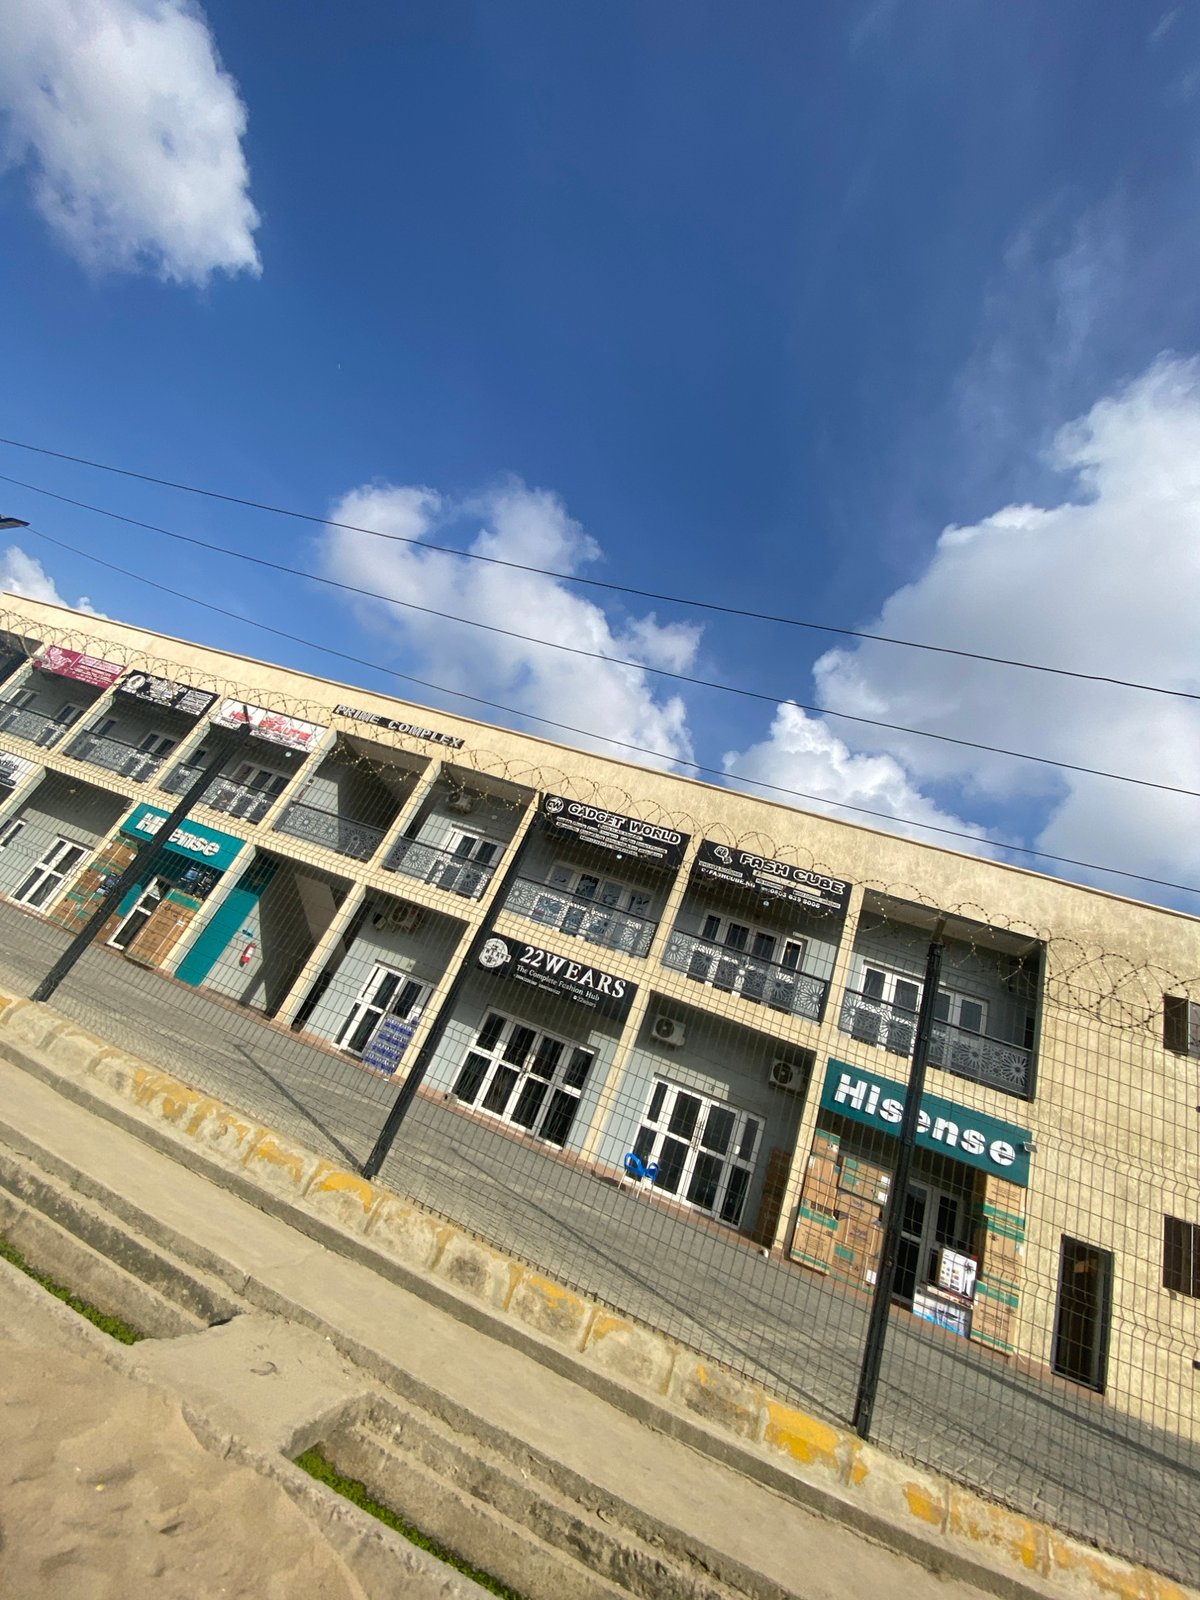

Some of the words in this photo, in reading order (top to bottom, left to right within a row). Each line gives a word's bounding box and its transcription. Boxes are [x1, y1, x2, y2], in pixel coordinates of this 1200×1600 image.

[335, 704, 381, 724] PRIME
[387, 720, 461, 748] COMPLEX
[568, 803, 625, 829] GADGET
[629, 821, 681, 845] WORLD
[740, 852, 790, 877] FASH
[793, 869, 846, 895] CUBE
[516, 964, 528, 975] The
[528, 968, 558, 986] Complete
[558, 980, 584, 996] Fashion
[585, 990, 600, 1002] Hub
[519, 945, 627, 999] 22WEARS
